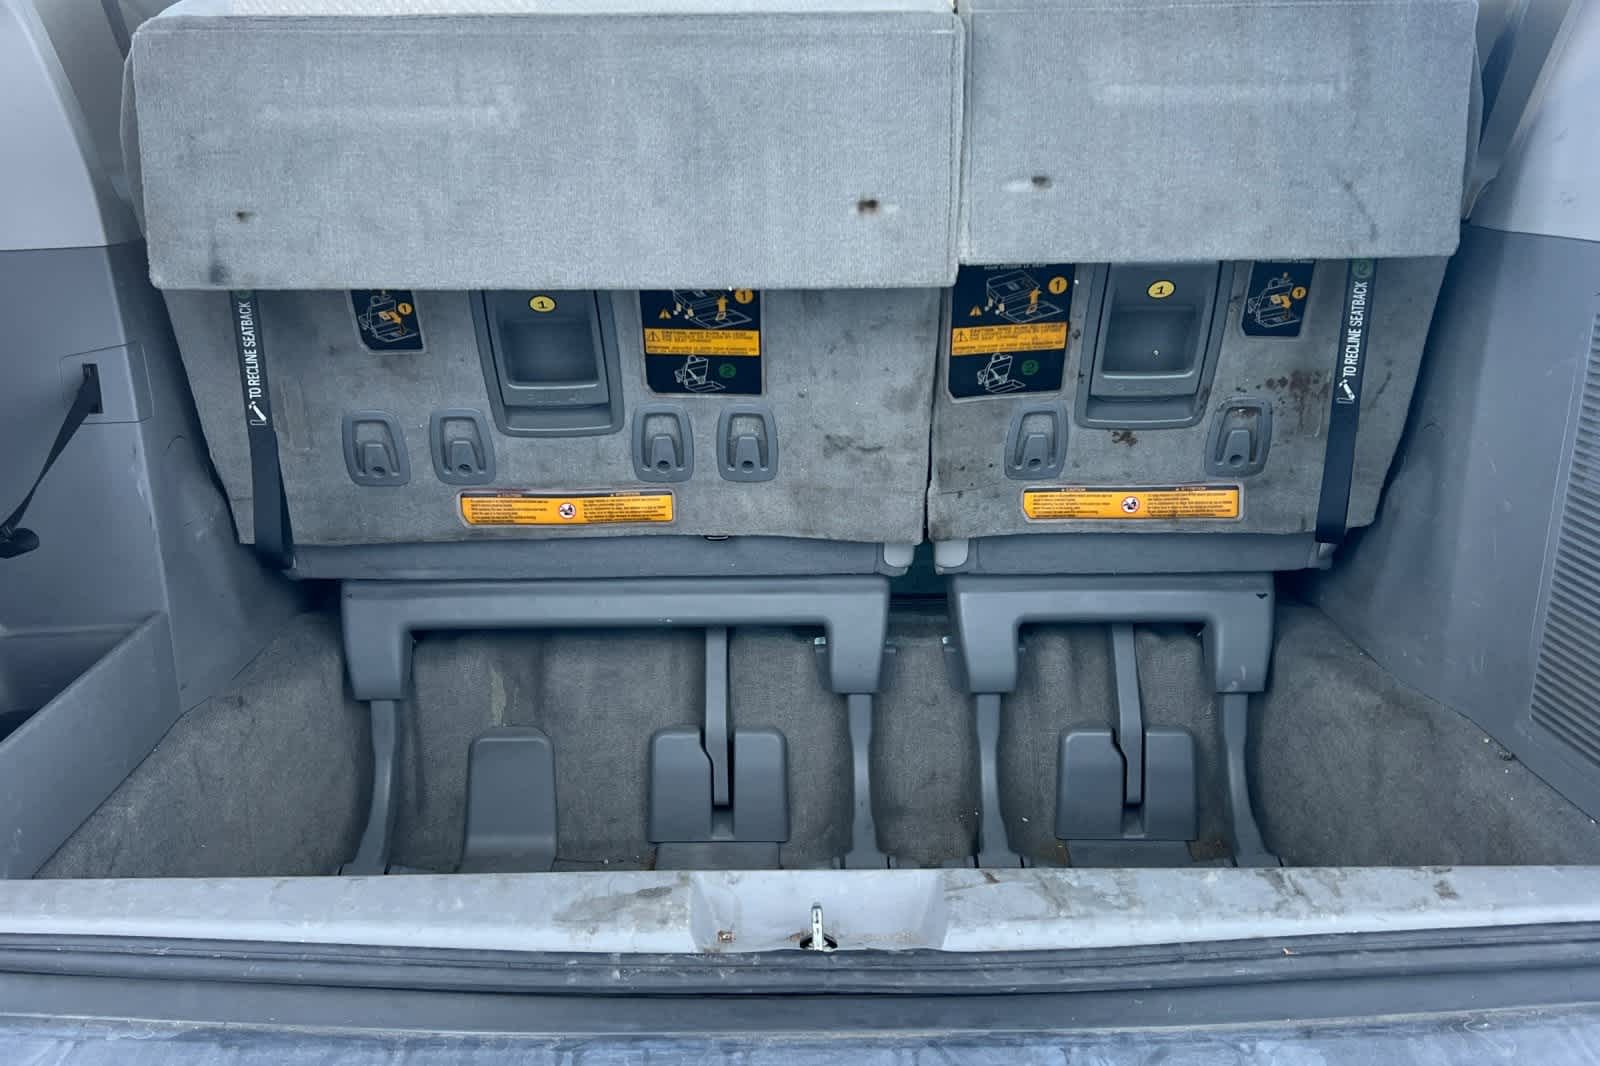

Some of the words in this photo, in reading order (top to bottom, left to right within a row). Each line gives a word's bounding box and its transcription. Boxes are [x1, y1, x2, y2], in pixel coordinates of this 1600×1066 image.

[1350, 281, 1368, 326] SEATBACK
[238, 302, 257, 347] SEATBACK
[1344, 328, 1362, 365] RECLINE
[244, 349, 260, 386] RECLINE
[1342, 366, 1356, 377] TO
[249, 387, 261, 399] TO
